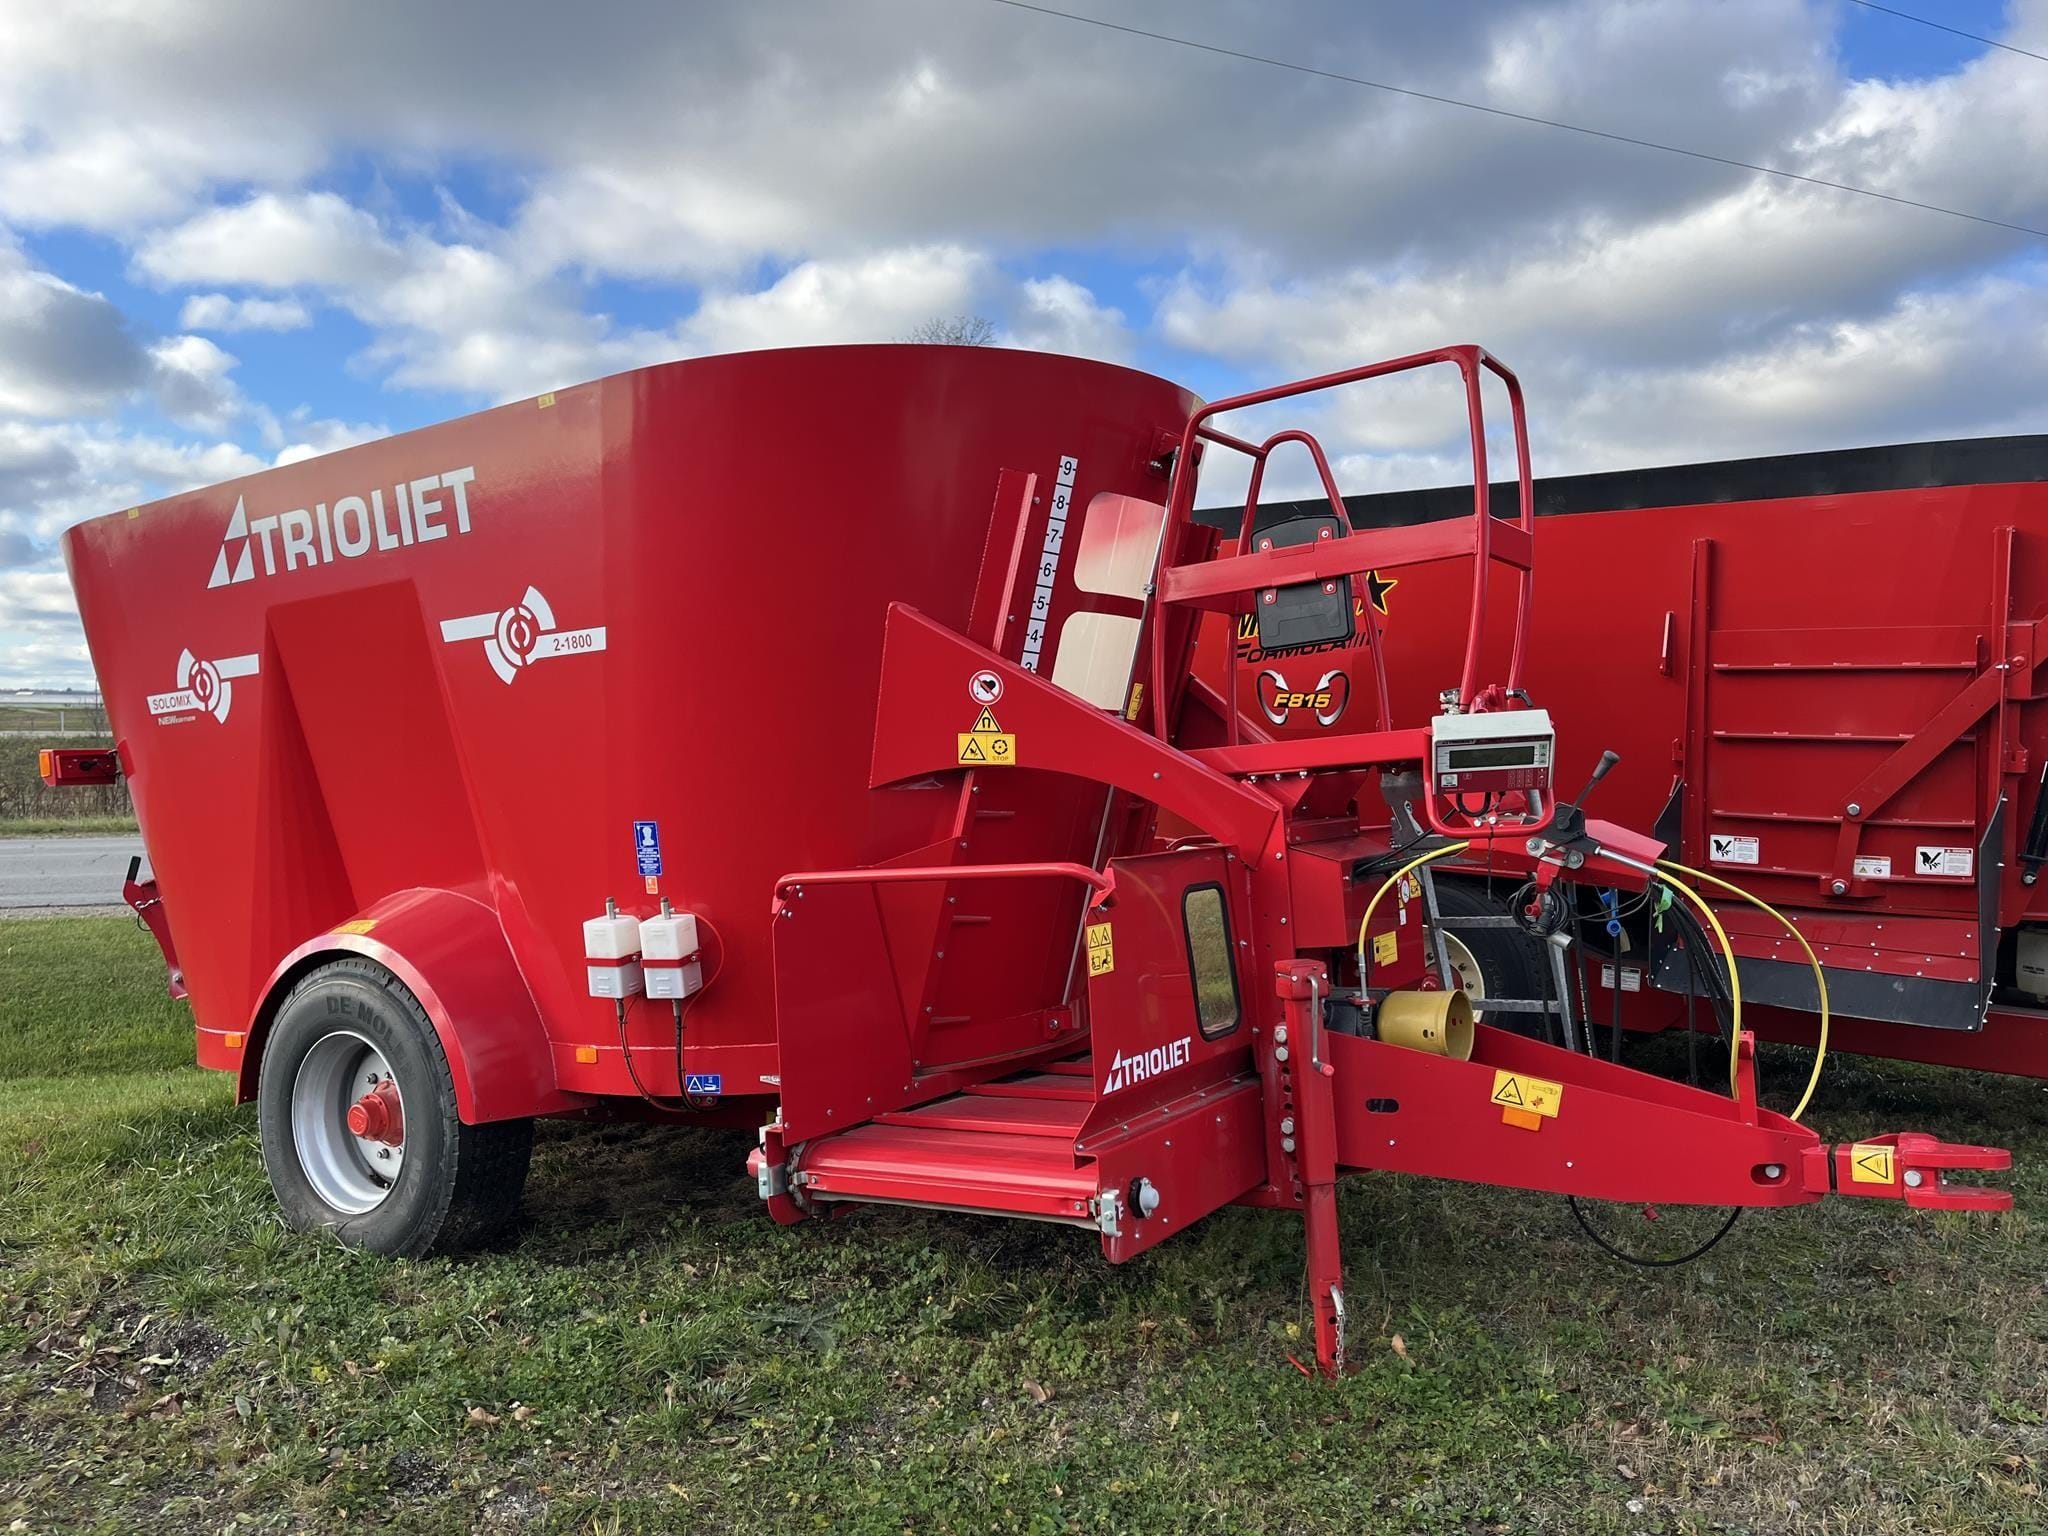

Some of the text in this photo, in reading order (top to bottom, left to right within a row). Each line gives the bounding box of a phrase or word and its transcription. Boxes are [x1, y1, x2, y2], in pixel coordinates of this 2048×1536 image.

[1063, 461, 1072, 475] 9
[1056, 495, 1065, 509] 8
[250, 466, 475, 576] TRIOLIET
[1050, 529, 1059, 543] 7
[1043, 563, 1051, 577] 6
[1036, 596, 1045, 610] 5
[553, 634, 592, 651] 2-1800
[1030, 629, 1038, 643] 4
[153, 694, 191, 710] SOLOMIX
[1274, 693, 1332, 708] F815
[326, 996, 351, 1015] DE
[1121, 1036, 1191, 1086] TRIOLIET
